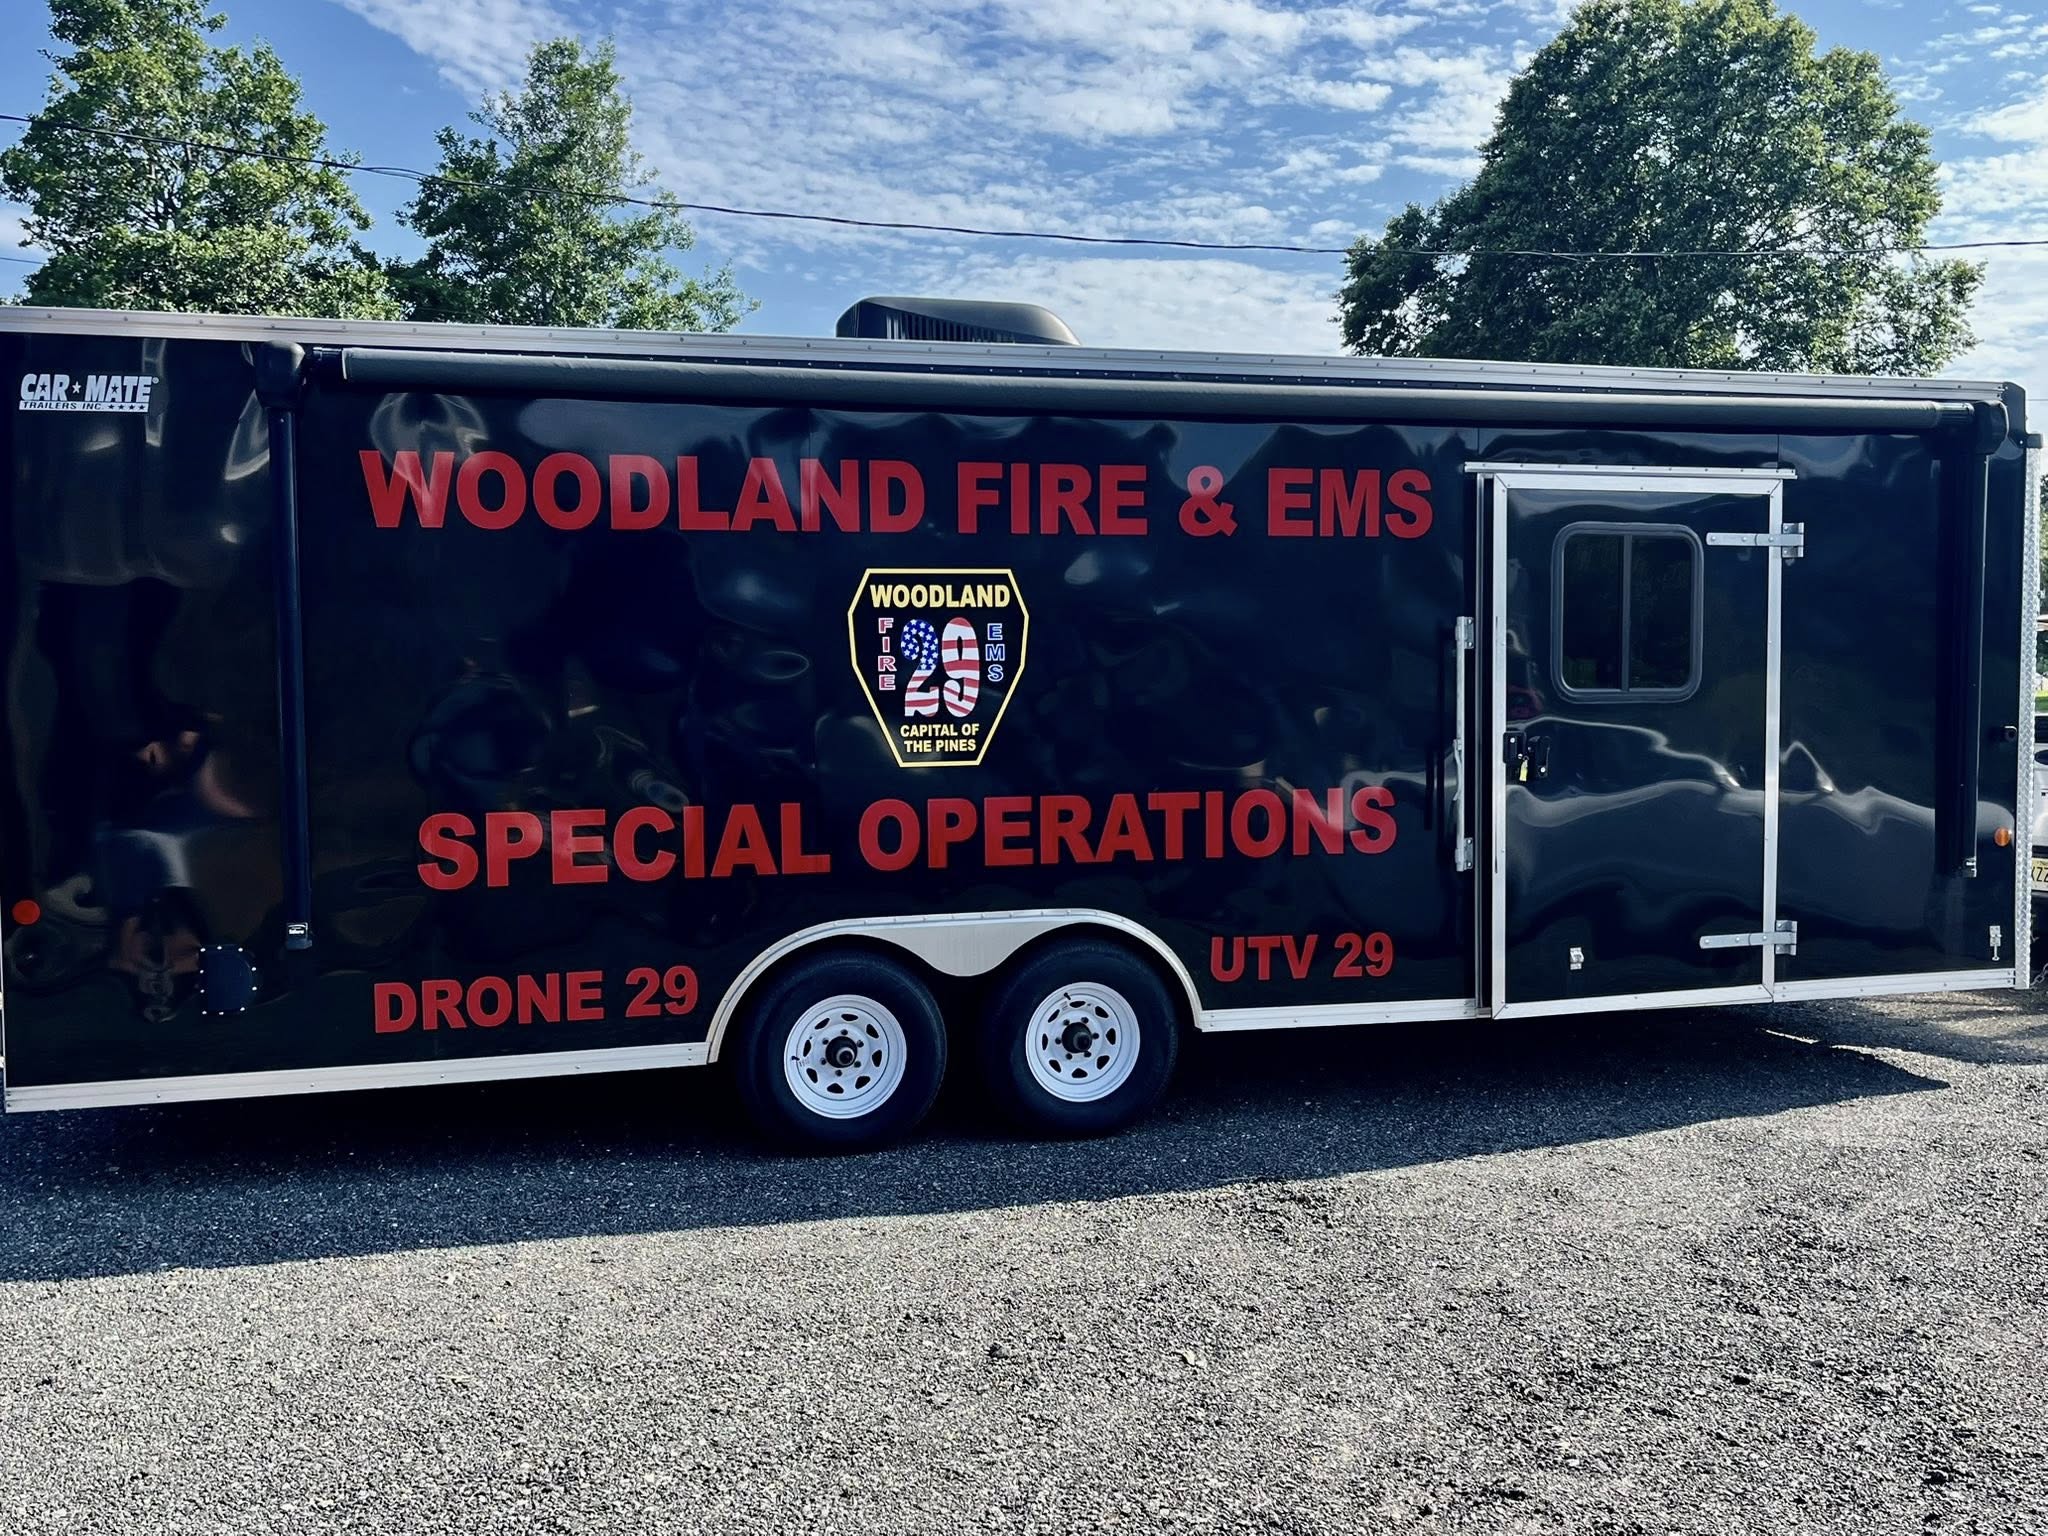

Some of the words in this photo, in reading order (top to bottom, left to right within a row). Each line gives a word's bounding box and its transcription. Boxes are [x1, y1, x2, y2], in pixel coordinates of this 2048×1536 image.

[20, 373, 70, 401] CAR
[84, 375, 152, 403] MATE
[23, 401, 77, 410] TRAILERS
[82, 402, 105, 410] INC.
[358, 449, 925, 533] WOODLAND
[957, 461, 1148, 536] FIRE
[1178, 465, 1238, 537] &
[1267, 467, 1433, 539] EMS
[870, 585, 1010, 608] WOODLAND
[878, 617, 897, 691] FIRE
[900, 616, 980, 718] 29
[985, 623, 1006, 682] EMS
[900, 724, 958, 737] CAPITAL
[961, 723, 980, 736] OF
[903, 740, 932, 753] THE
[935, 739, 977, 752] PINES
[417, 802, 831, 890] SPECIAL
[858, 786, 1397, 871] OPERATIONS
[1210, 934, 1319, 983] UTV
[1333, 932, 1394, 978] 29
[374, 970, 604, 1034] DRONE
[625, 965, 698, 1018] 29
